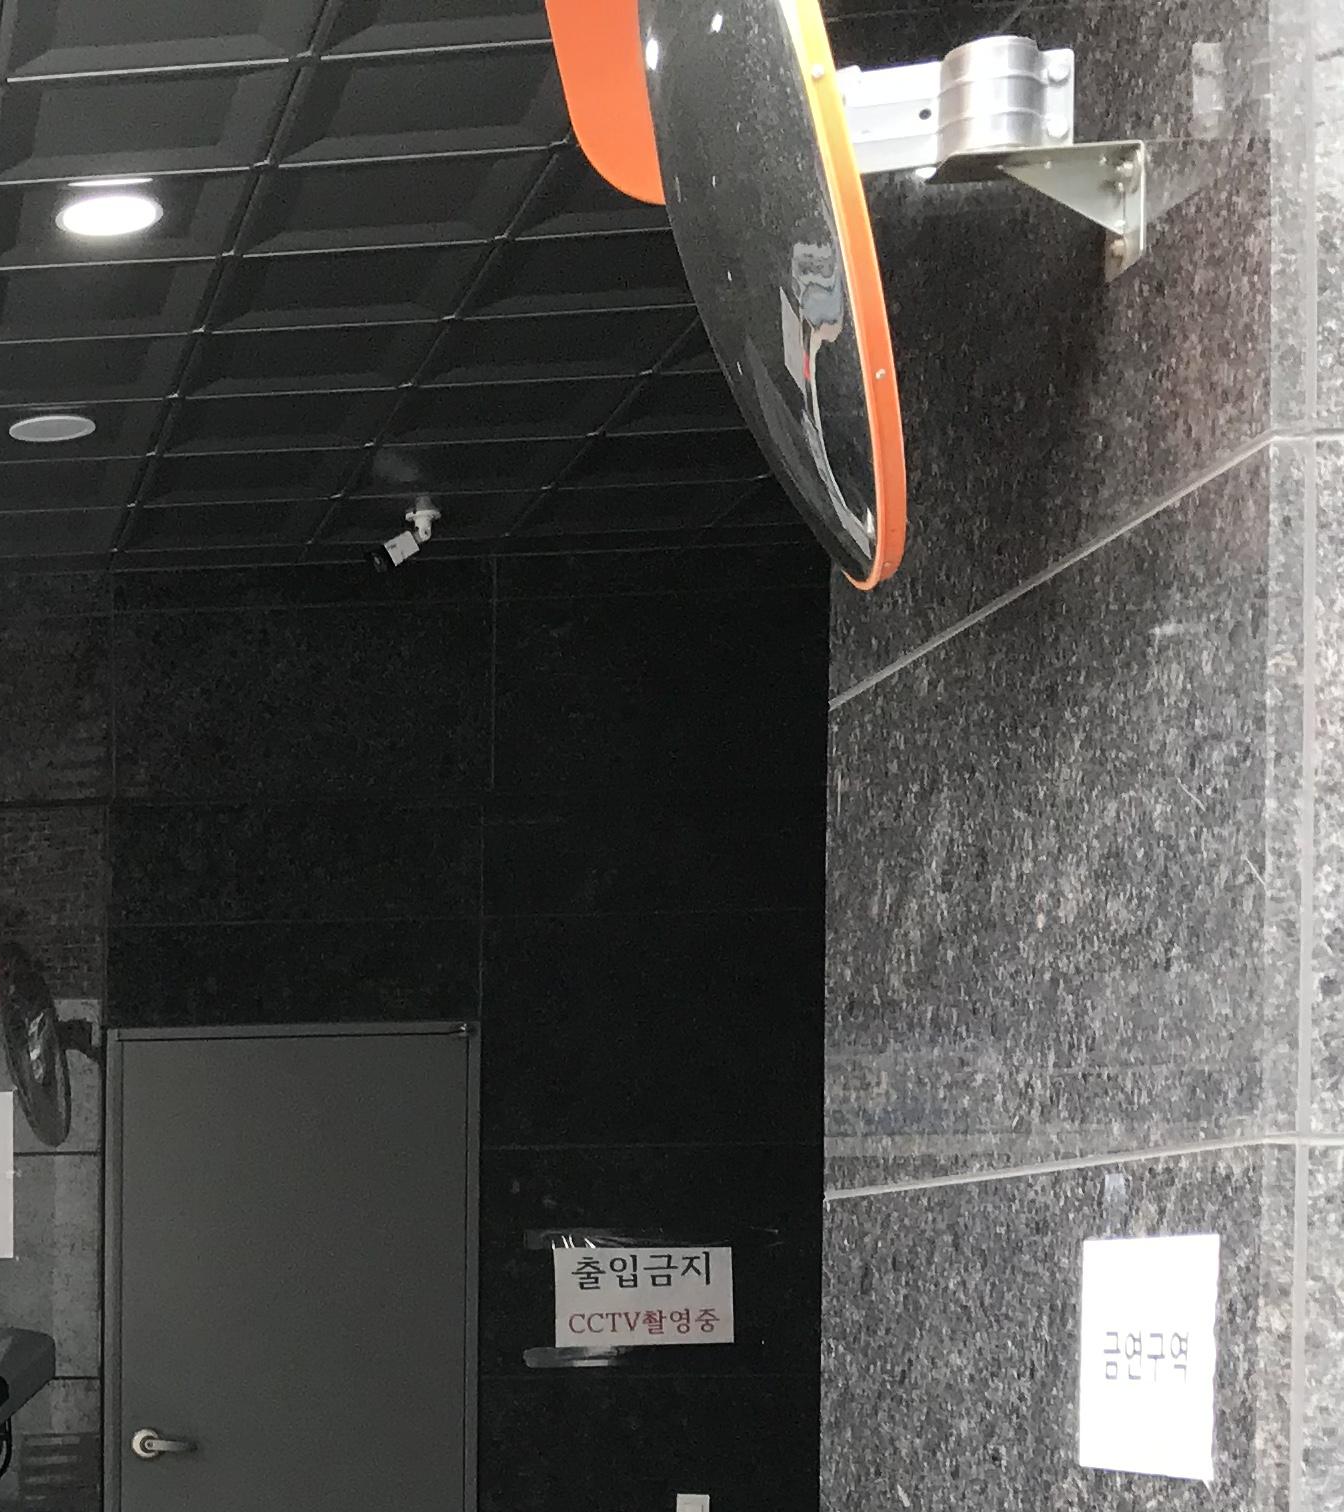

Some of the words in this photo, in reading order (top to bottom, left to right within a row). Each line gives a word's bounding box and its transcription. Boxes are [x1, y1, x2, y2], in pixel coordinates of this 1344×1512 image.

[571, 1251, 711, 1290] 출입금지
[569, 1308, 720, 1335] CCTV촬영중
[1104, 1330, 1190, 1383] 금연구역
